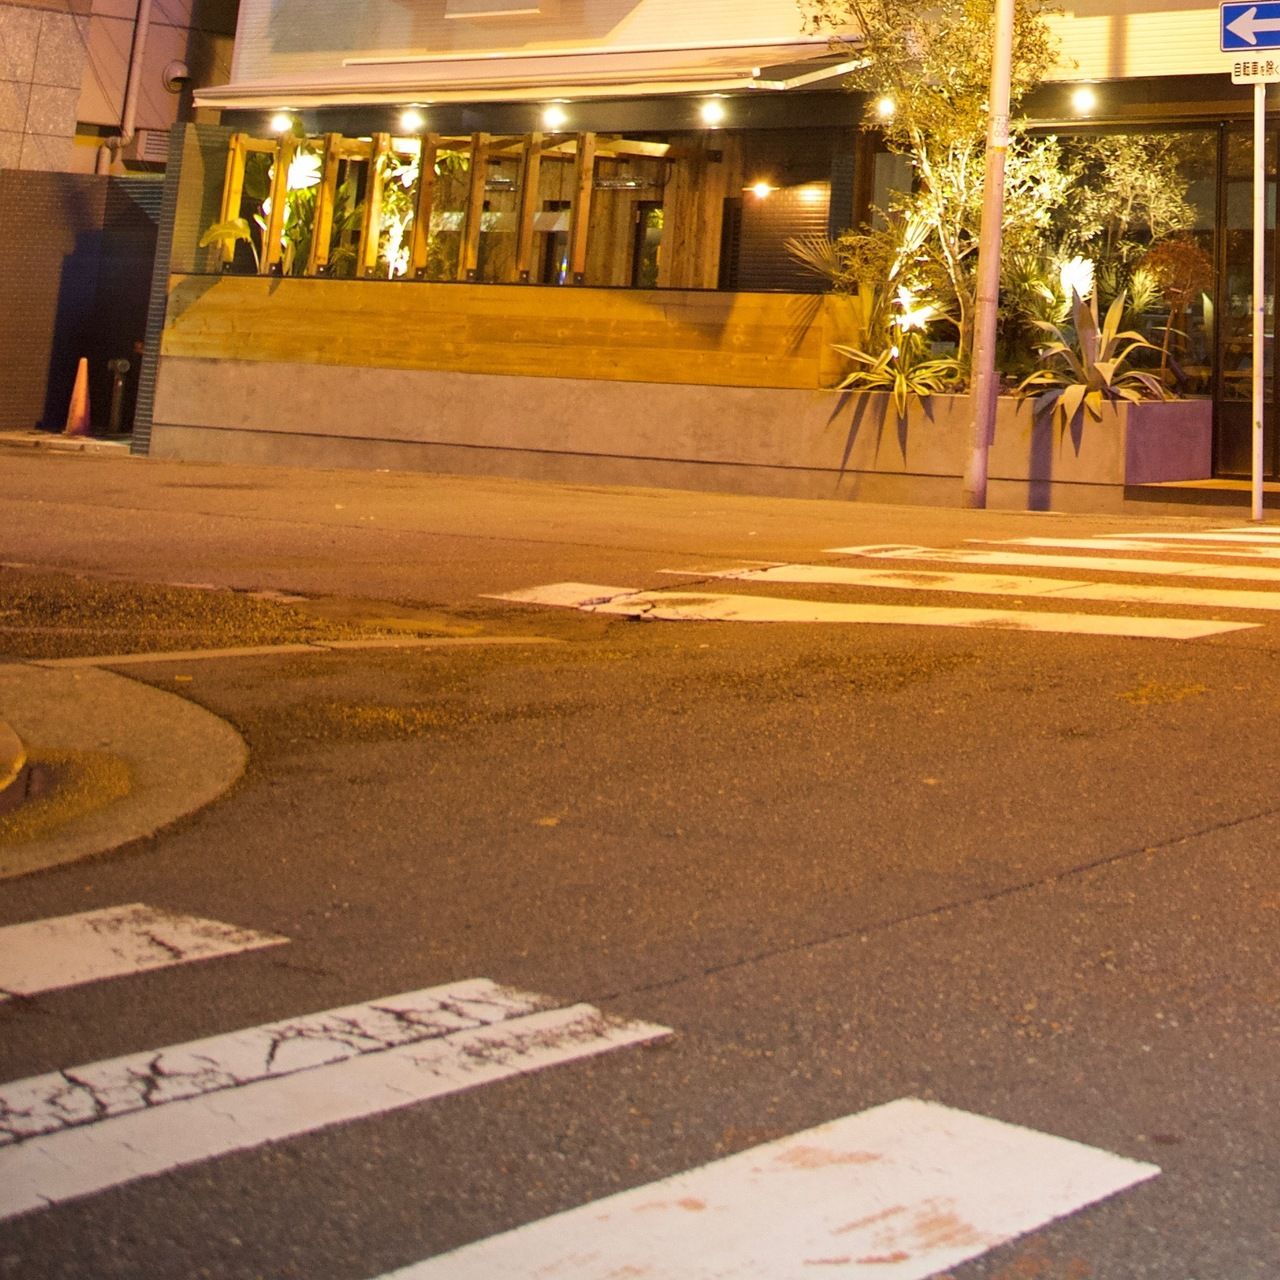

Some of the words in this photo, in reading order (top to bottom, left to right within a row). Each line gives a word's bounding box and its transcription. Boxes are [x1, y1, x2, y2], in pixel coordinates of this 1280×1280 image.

[1234, 60, 1279, 77] 自転車を除く
